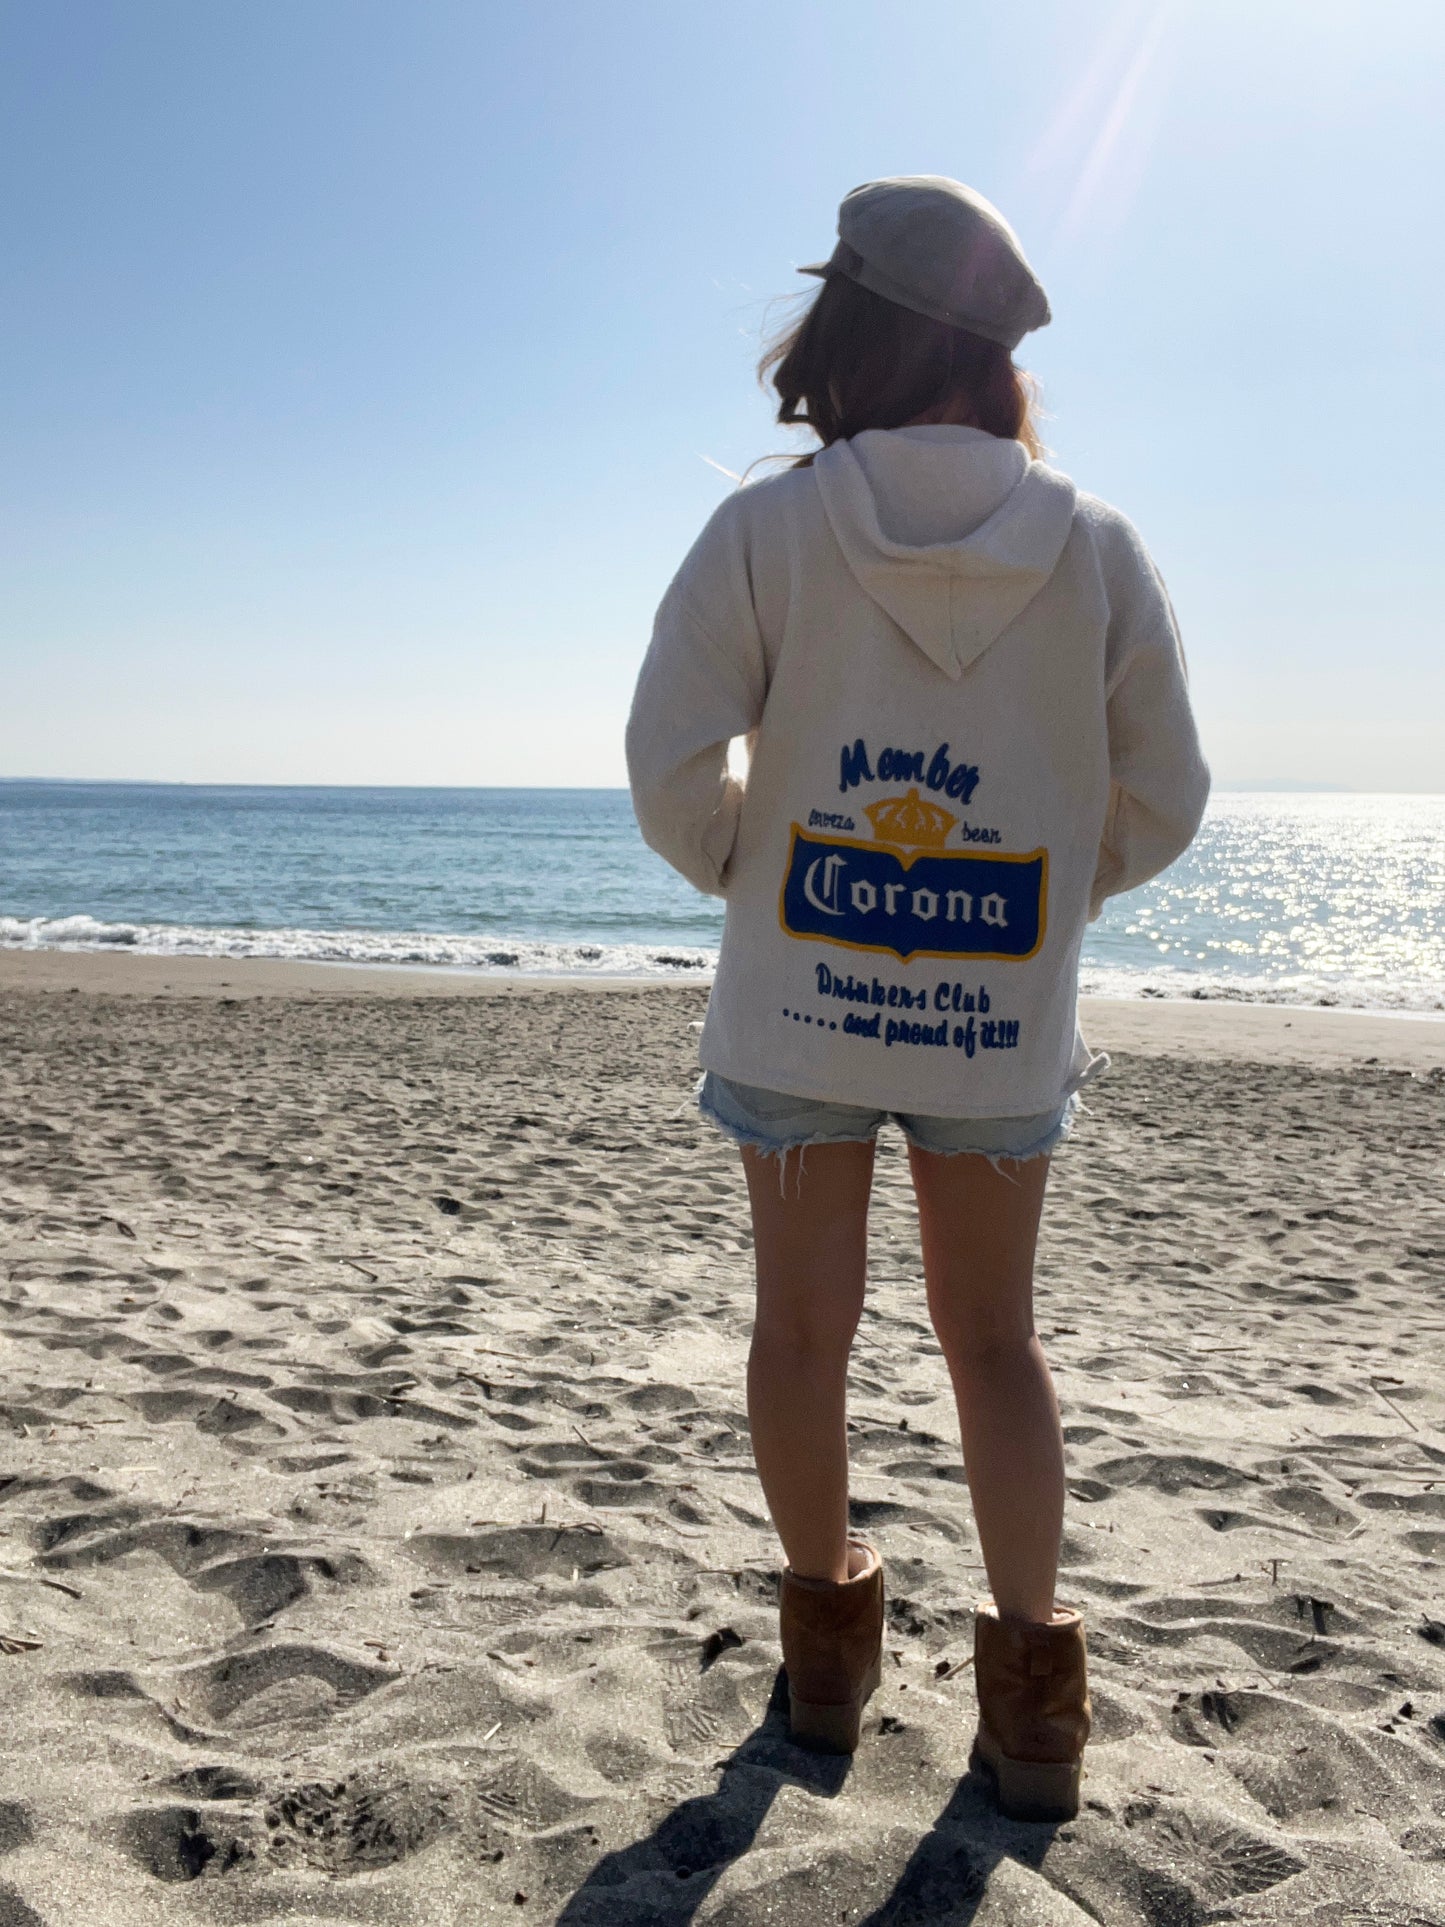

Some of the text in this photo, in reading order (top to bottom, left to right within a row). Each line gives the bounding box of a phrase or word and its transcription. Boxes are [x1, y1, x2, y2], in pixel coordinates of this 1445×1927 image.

[839, 739, 980, 805] Member
[803, 853, 1010, 928] Corona
[815, 962, 990, 1013] Drinkers Club
[885, 1018, 948, 1047] proud
[953, 1016, 976, 1058] of
